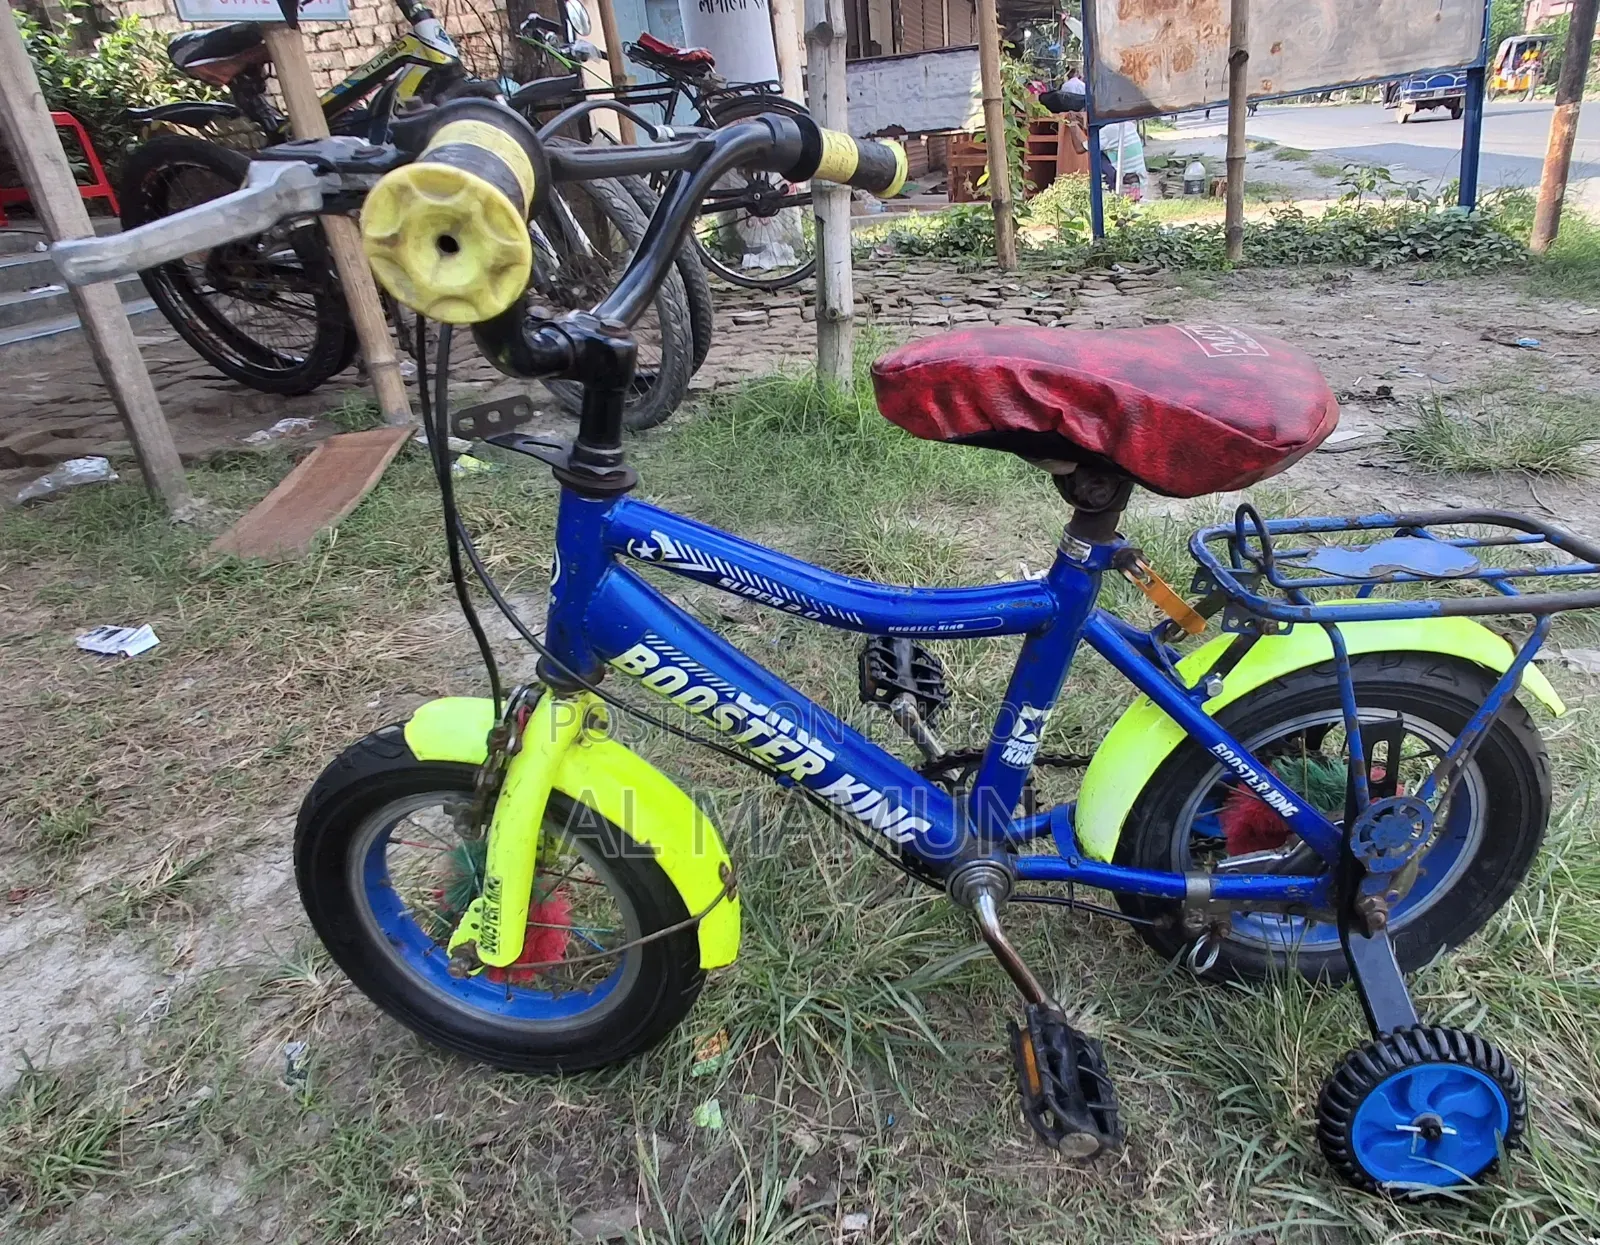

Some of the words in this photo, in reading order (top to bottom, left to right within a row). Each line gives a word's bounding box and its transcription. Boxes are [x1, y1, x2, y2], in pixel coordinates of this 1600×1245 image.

[717, 577, 785, 605] SUPER
[782, 598, 822, 620] 2.0
[609, 643, 826, 782] BOOSTER
[816, 773, 932, 843] KING
[1212, 742, 1270, 793] BOOSTER
[1263, 788, 1300, 817] KING
